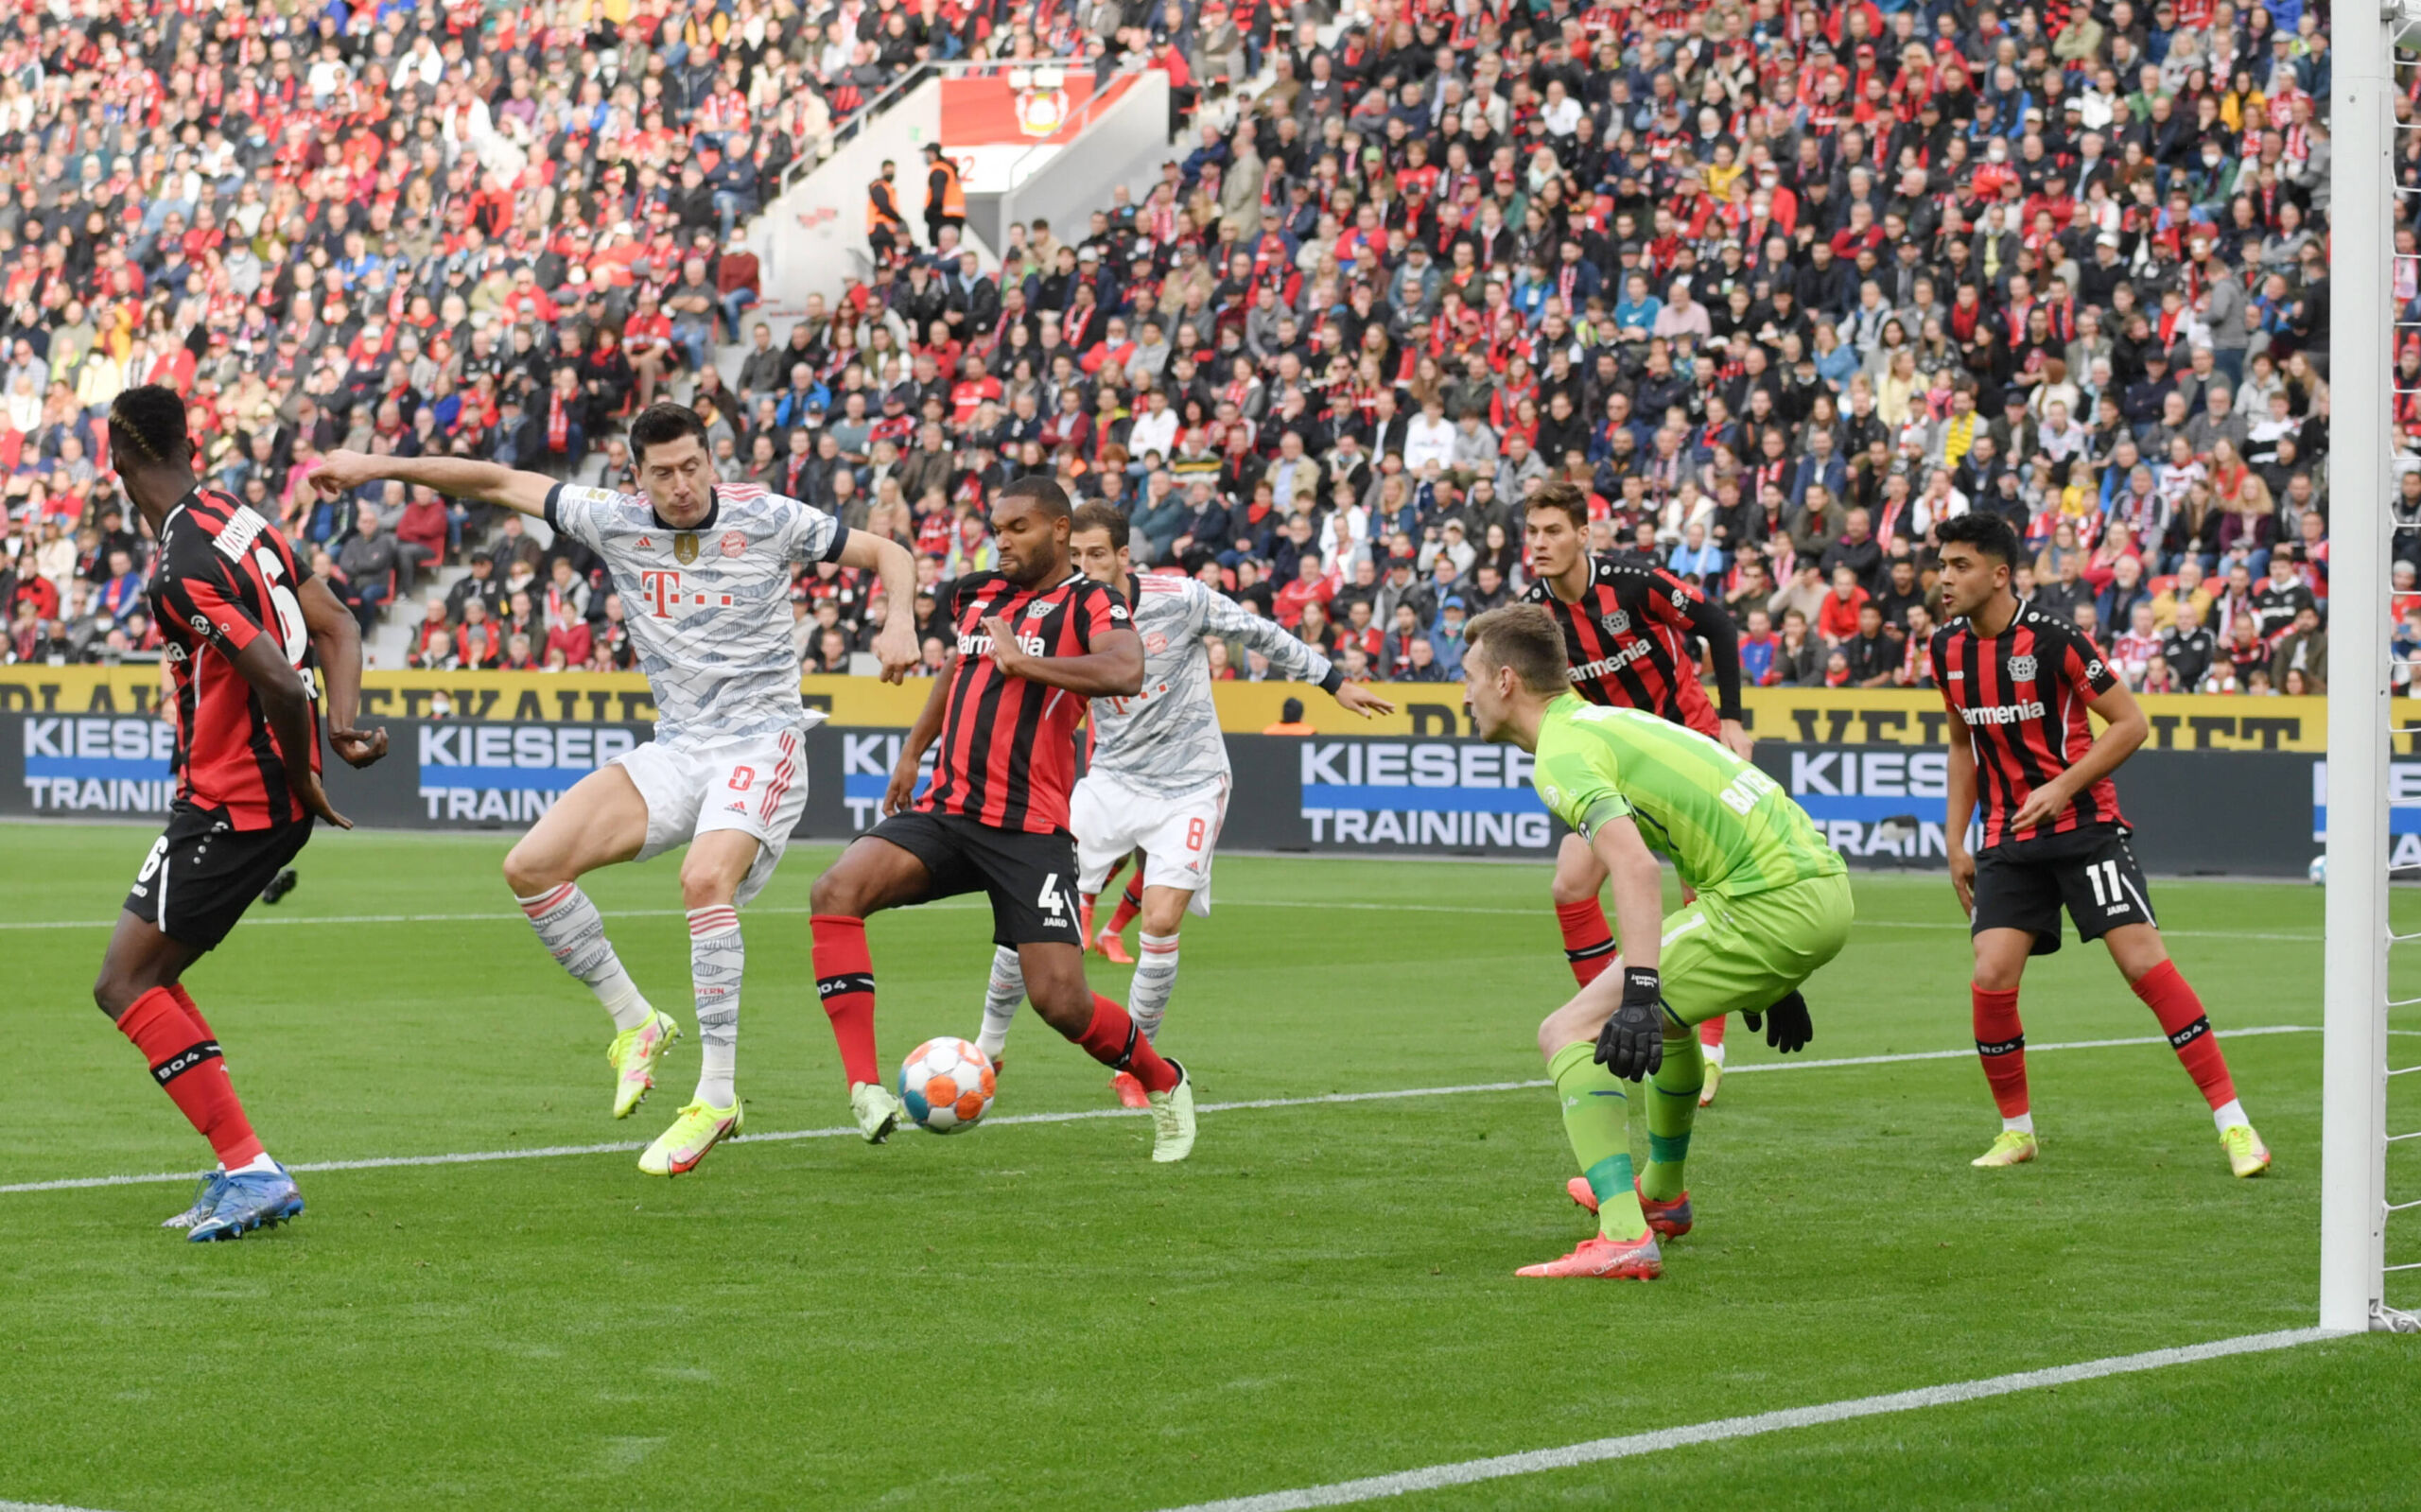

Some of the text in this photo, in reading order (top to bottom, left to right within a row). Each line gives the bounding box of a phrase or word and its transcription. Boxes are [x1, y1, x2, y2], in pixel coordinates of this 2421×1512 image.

[255, 547, 308, 666] 6
[1565, 637, 1653, 683] armenia
[1953, 698, 2047, 726] armenia
[24, 717, 177, 760] KIESE
[1301, 741, 1536, 790] KIESER
[1790, 750, 1949, 798] KIES
[418, 786, 567, 823] TRAIN
[1186, 816, 1215, 852] 8
[1301, 808, 1552, 848] TRAINING
[137, 835, 169, 883] 6
[1037, 872, 1065, 917] 4
[2085, 859, 2124, 907] 11
[1042, 916, 1069, 929] JAKO
